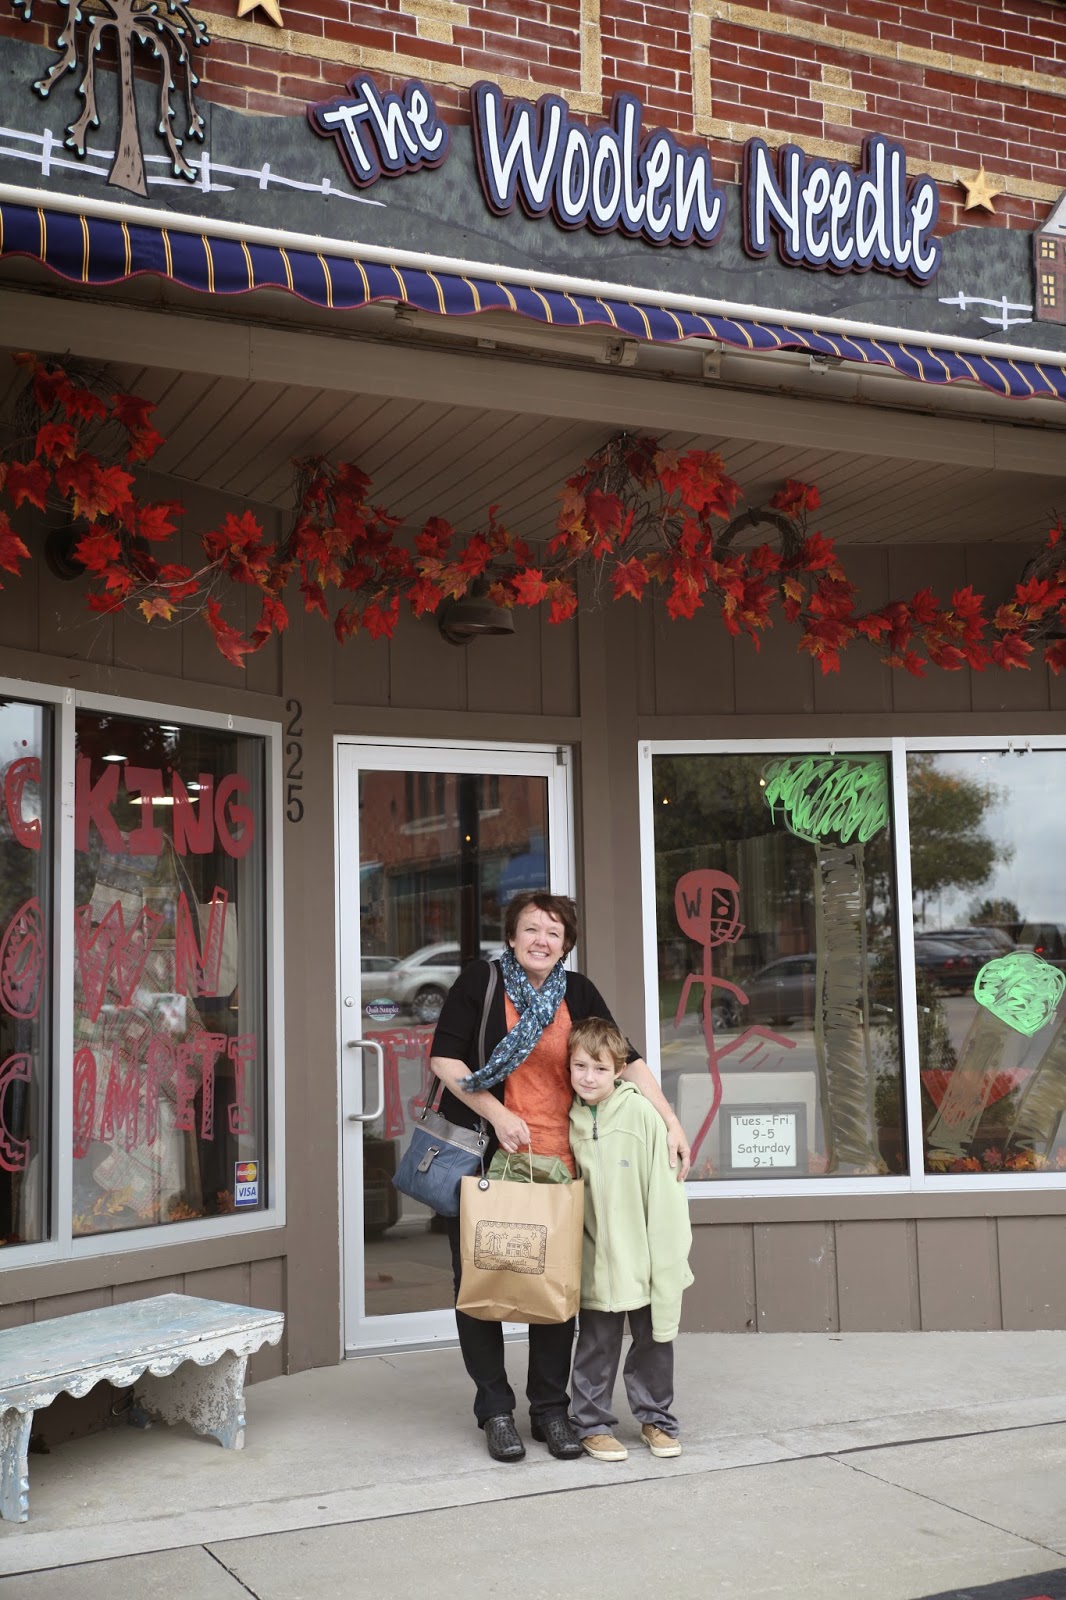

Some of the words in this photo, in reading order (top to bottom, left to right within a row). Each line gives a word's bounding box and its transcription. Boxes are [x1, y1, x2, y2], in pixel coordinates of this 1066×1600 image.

[322, 80, 444, 173] The
[483, 92, 722, 234] Woolen
[755, 134, 939, 274] Needle
[286, 698, 304, 823] 225
[682, 887, 702, 919] W
[752, 1128, 775, 1140] 9-5
[737, 1142, 791, 1155] Saturday
[753, 1156, 774, 1168] 9-1
[239, 1186, 256, 1198] VISA
